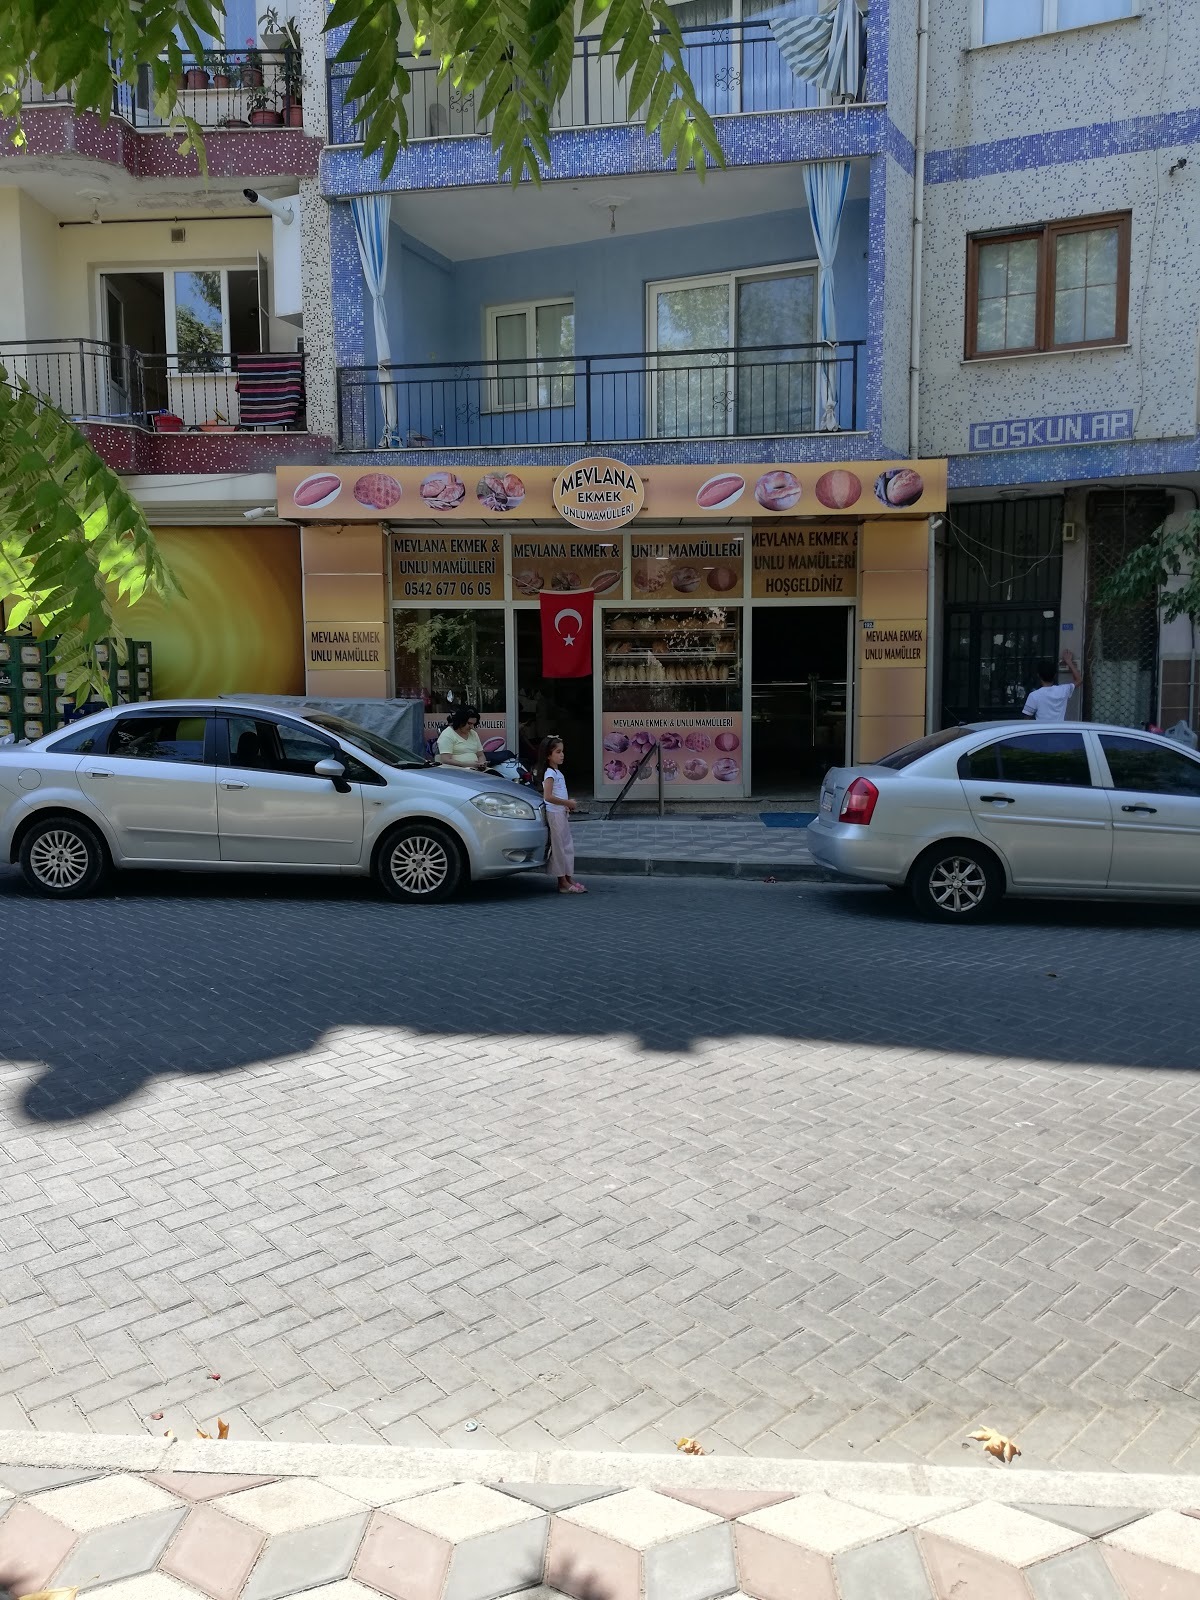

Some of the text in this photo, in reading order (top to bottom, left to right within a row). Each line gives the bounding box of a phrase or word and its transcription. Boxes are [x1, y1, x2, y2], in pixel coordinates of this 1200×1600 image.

[561, 466, 637, 496] MEVLANA
[578, 491, 622, 502] EKMEK
[394, 538, 500, 552] MEVLANA EKMEK &
[752, 532, 804, 546] MEVLANA
[808, 532, 848, 546] EKMEK
[514, 544, 620, 557] MEVLANA EKMEK &
[632, 540, 741, 558] UNLU MAMÜLLERİ
[400, 558, 495, 574] UNLU MAMÜLLERİ
[754, 551, 856, 569] UNLU MAMÜLLERİ
[404, 582, 491, 595] 0542 677 06 05
[766, 574, 843, 596] HOŞGELDİNİZ
[312, 632, 380, 643] MEVLANA EKMEK
[866, 630, 922, 642] MEVLANA EKMEK
[311, 648, 379, 662] UNLU MAMÜLLER
[866, 645, 921, 660] UNLU MAMÜLLER
[614, 719, 644, 727] MEVLANA
[646, 719, 668, 727] EKMEK
[696, 717, 733, 727] MAMÜLLERİ
